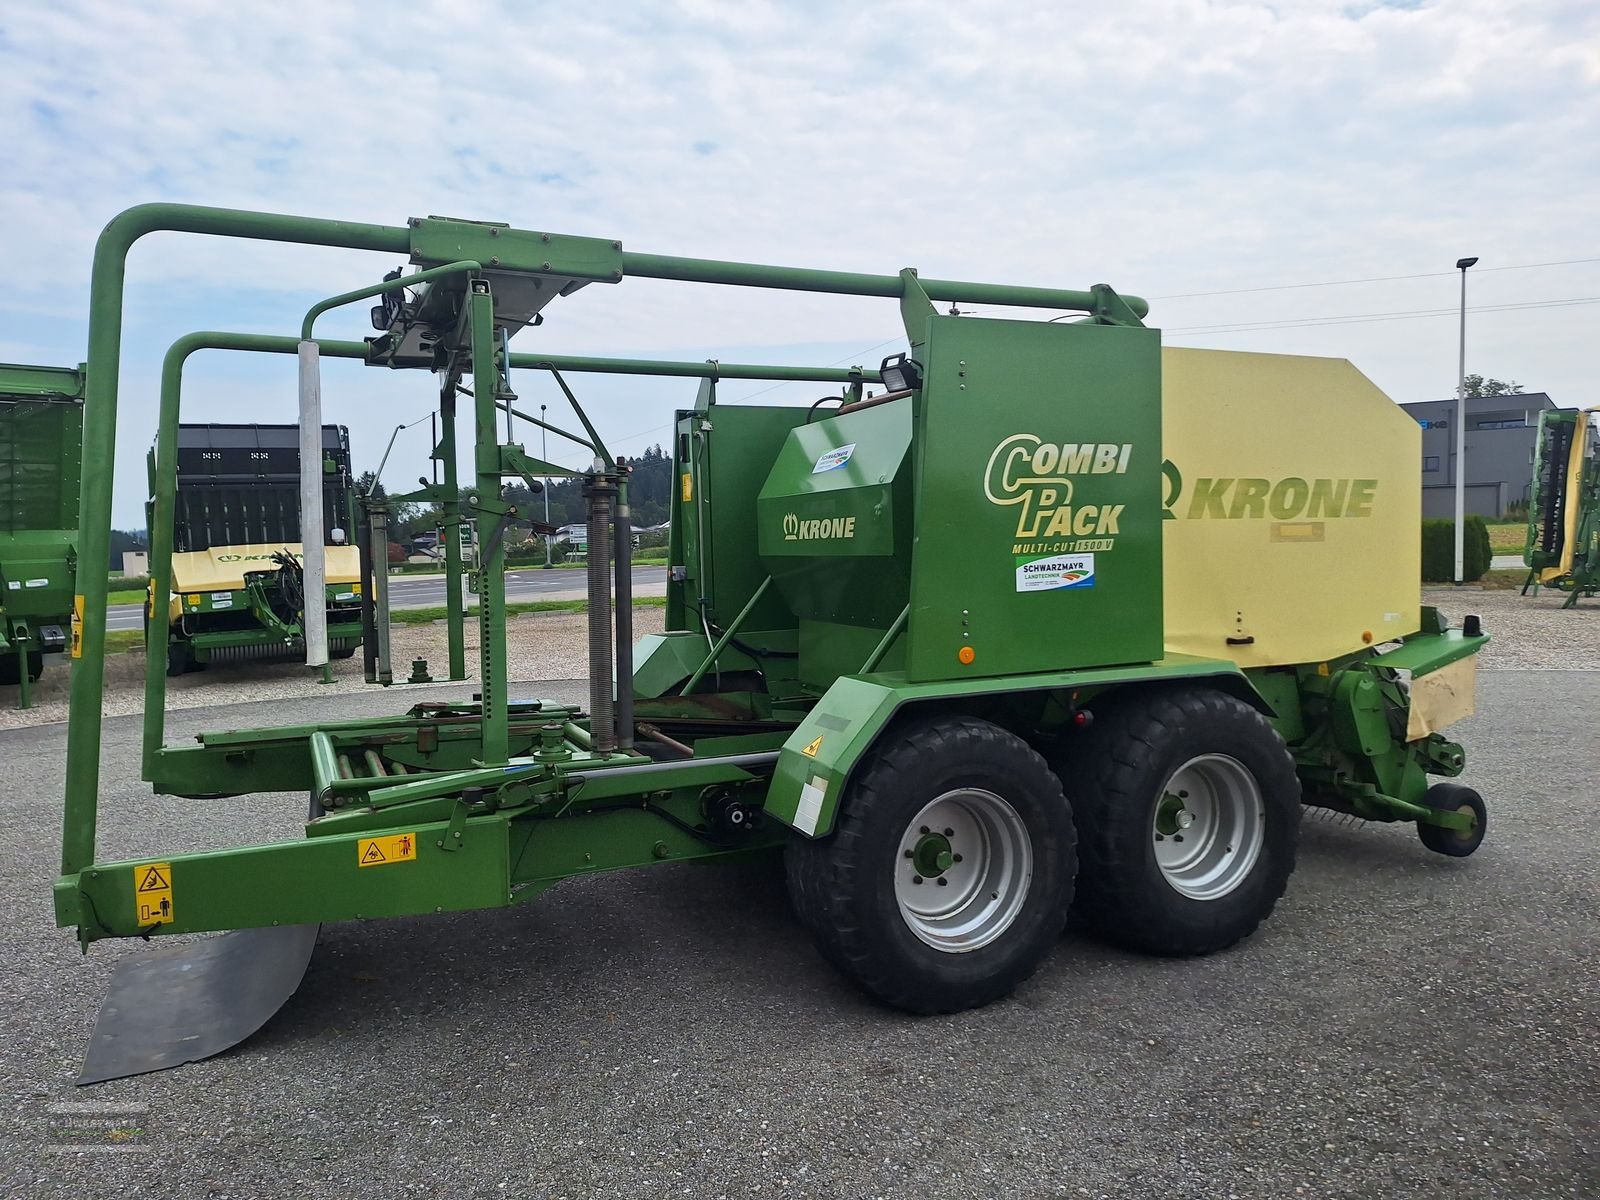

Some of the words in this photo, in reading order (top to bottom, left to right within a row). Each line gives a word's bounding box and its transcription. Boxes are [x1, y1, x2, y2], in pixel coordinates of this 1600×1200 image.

[983, 433, 1133, 506] COMBI
[1015, 478, 1126, 538] PACK
[1186, 477, 1379, 520] KRONE
[798, 516, 856, 540] KRONE
[1012, 541, 1076, 554] MULTI-CUT
[1077, 540, 1102, 551] 1500
[1023, 562, 1084, 573] SCHWARZMAYR
